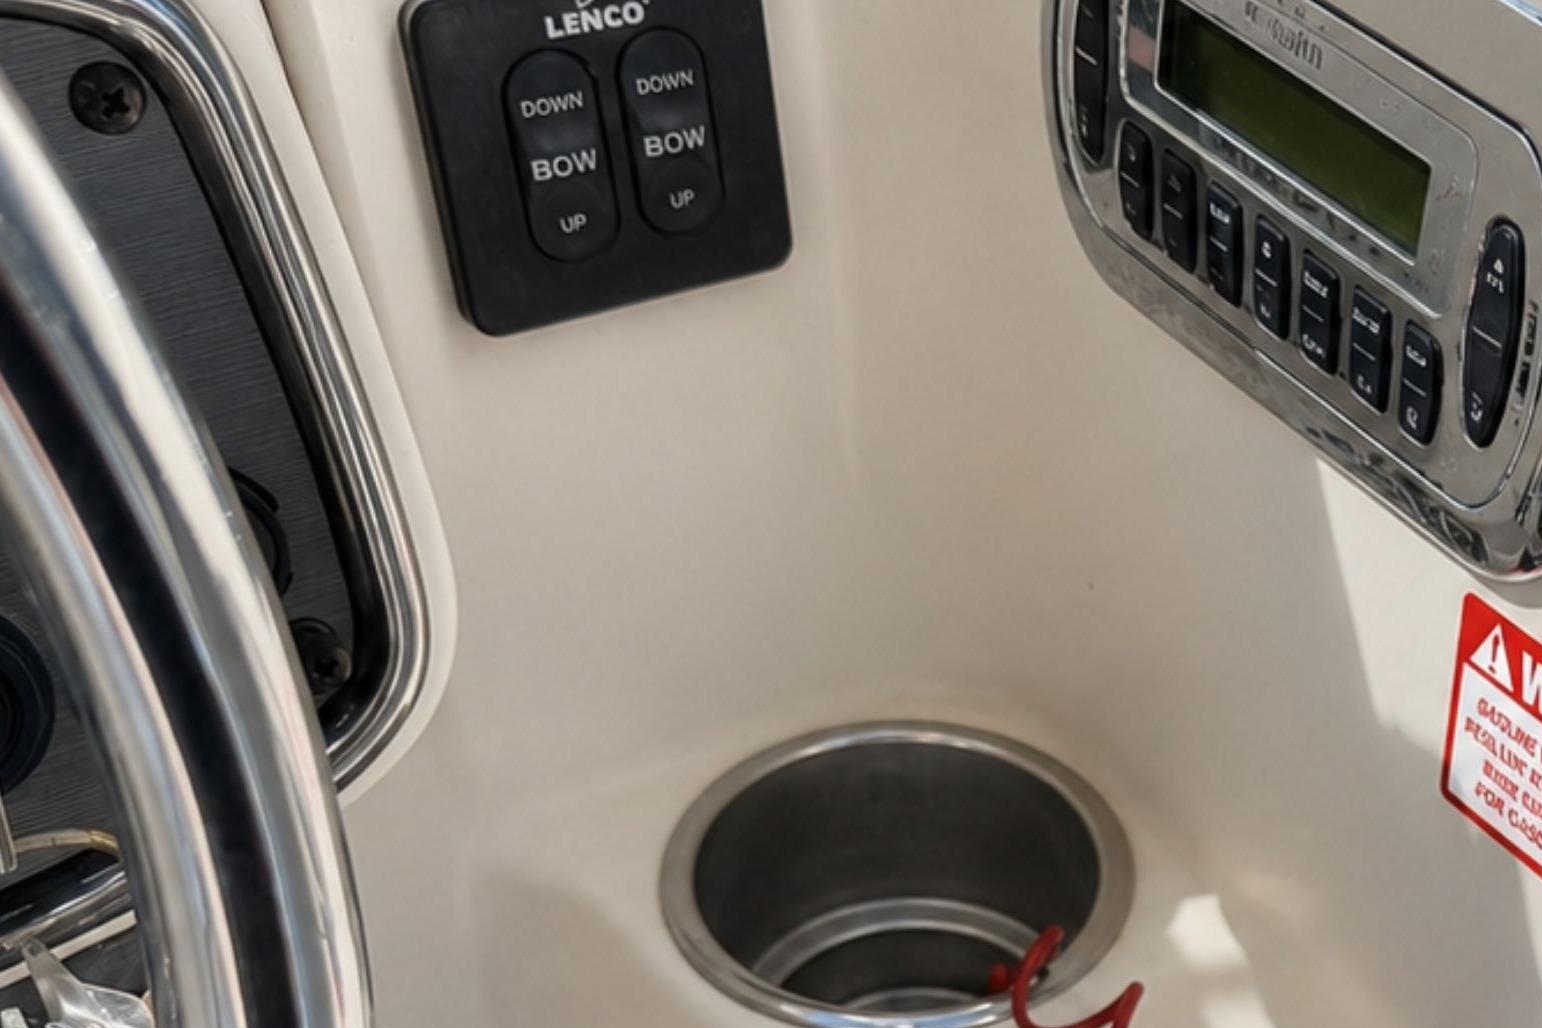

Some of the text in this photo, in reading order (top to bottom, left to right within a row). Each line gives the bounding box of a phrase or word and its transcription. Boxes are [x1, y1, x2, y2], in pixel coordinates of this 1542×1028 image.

[545, 1, 645, 39] LENCO
[636, 70, 694, 96] DOWN
[521, 92, 584, 118] DOWN
[643, 126, 706, 157] BOW
[531, 149, 597, 182] BOW
[670, 190, 696, 209] UP
[560, 214, 587, 234] UP
